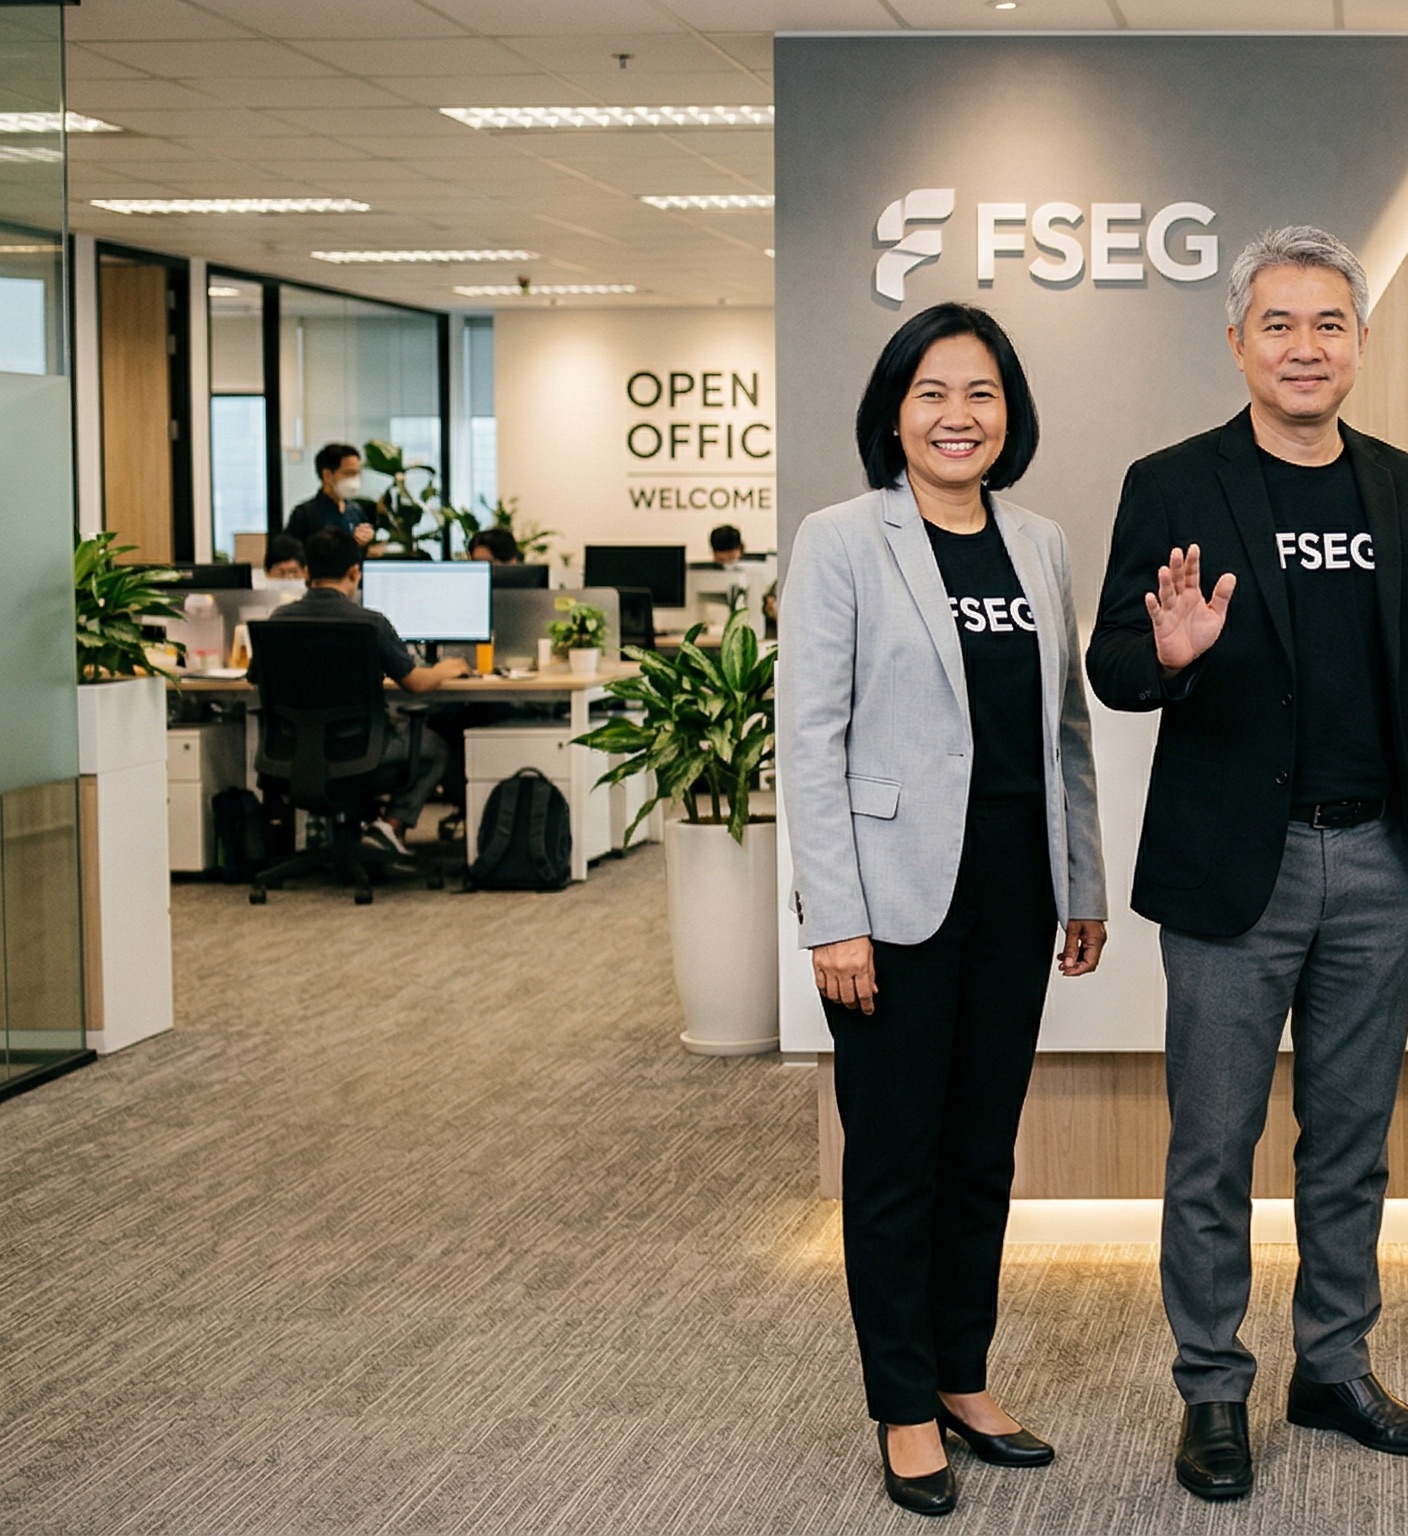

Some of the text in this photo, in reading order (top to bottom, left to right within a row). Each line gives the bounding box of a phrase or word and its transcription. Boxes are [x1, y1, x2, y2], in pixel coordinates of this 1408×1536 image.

[977, 202, 1219, 282] FSEG
[627, 372, 758, 407] OPEN
[627, 423, 771, 458] OFFIC
[629, 488, 771, 510] WELCOME
[1275, 532, 1376, 570] FSEG
